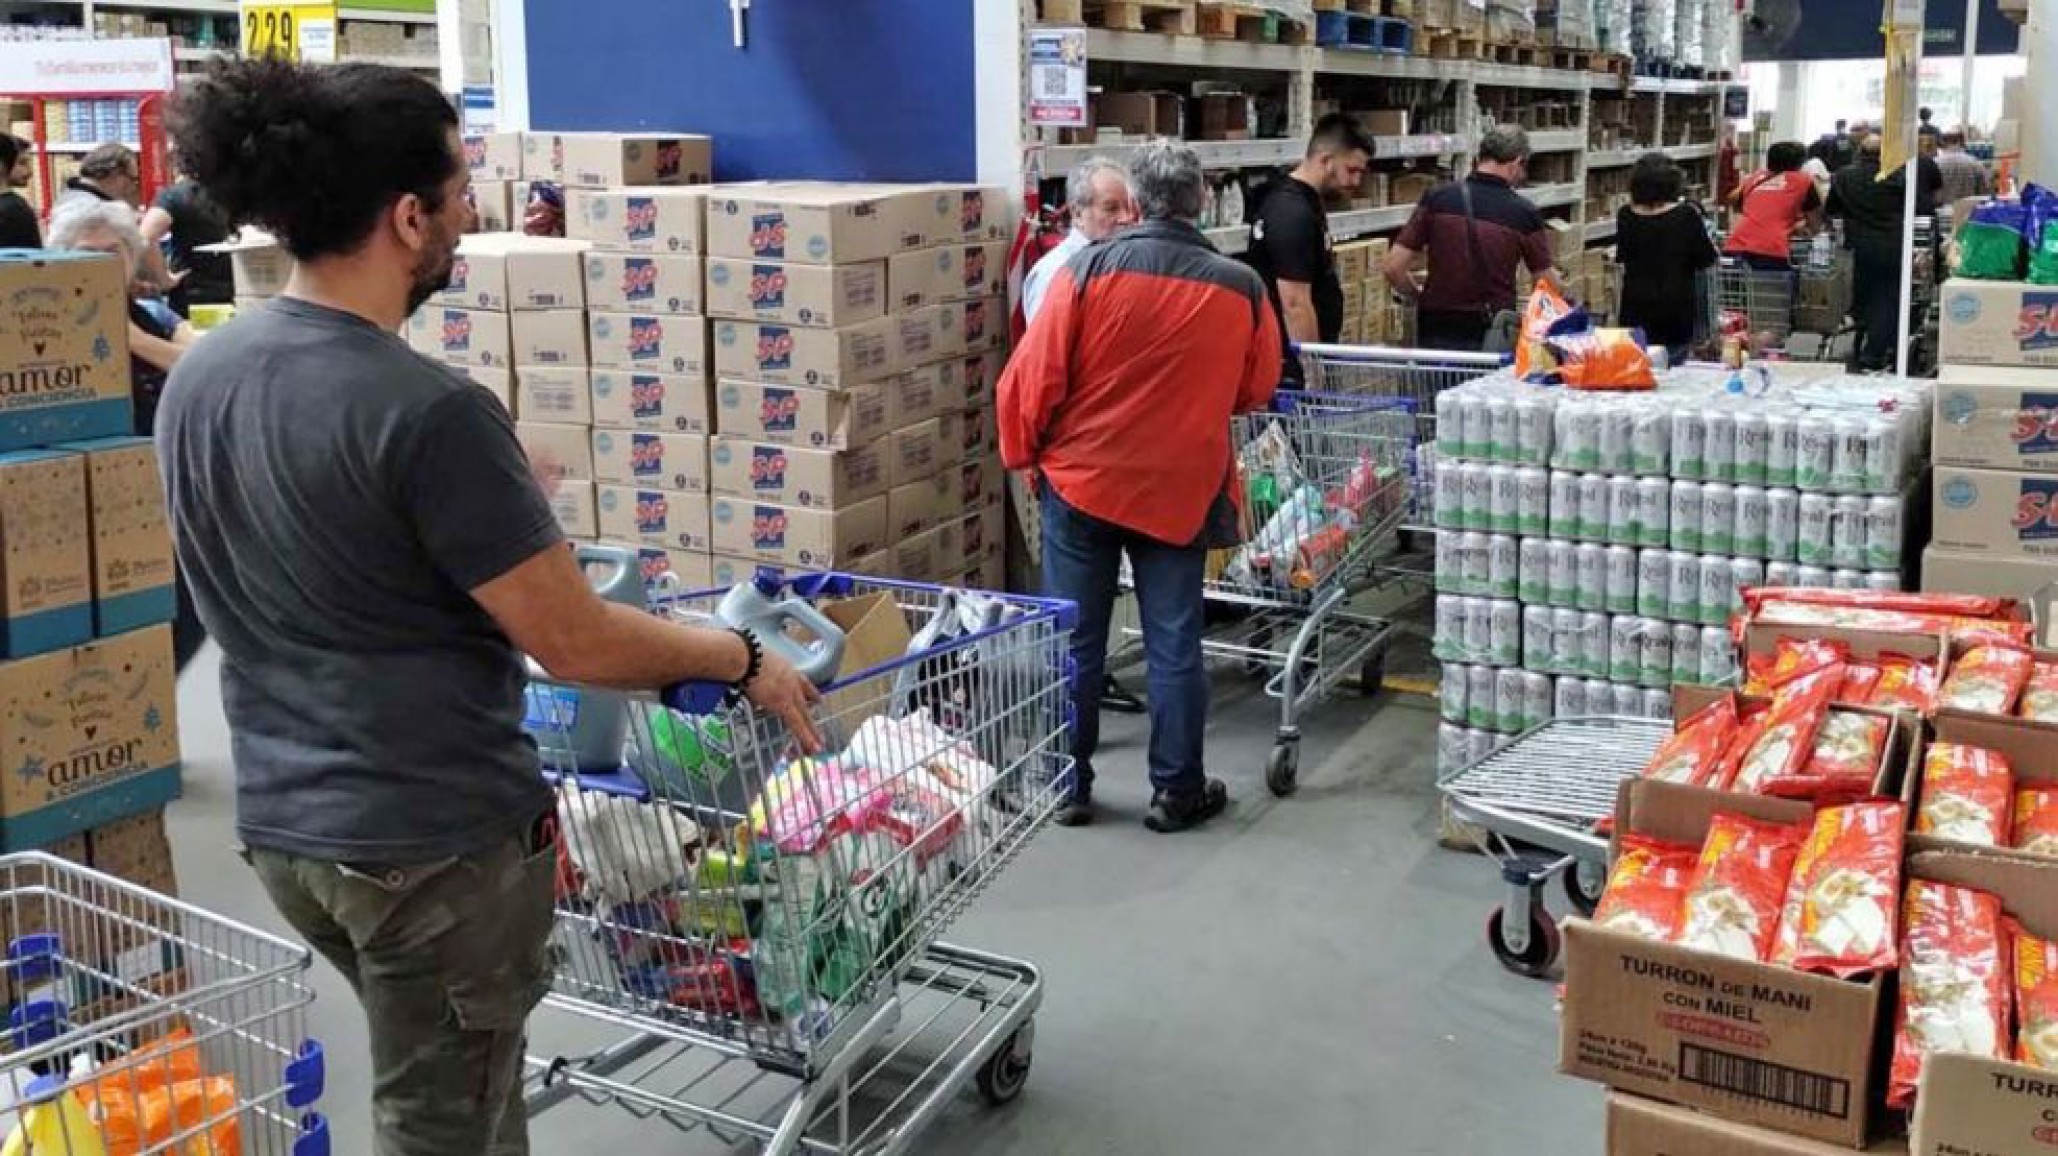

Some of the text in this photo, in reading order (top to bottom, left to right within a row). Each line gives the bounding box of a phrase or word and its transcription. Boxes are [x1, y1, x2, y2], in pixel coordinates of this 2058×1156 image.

[48, 737, 143, 787] amor
[1620, 955, 1812, 1011] TURRON DE MANI
[1663, 991, 1761, 1023] CON MIEL
